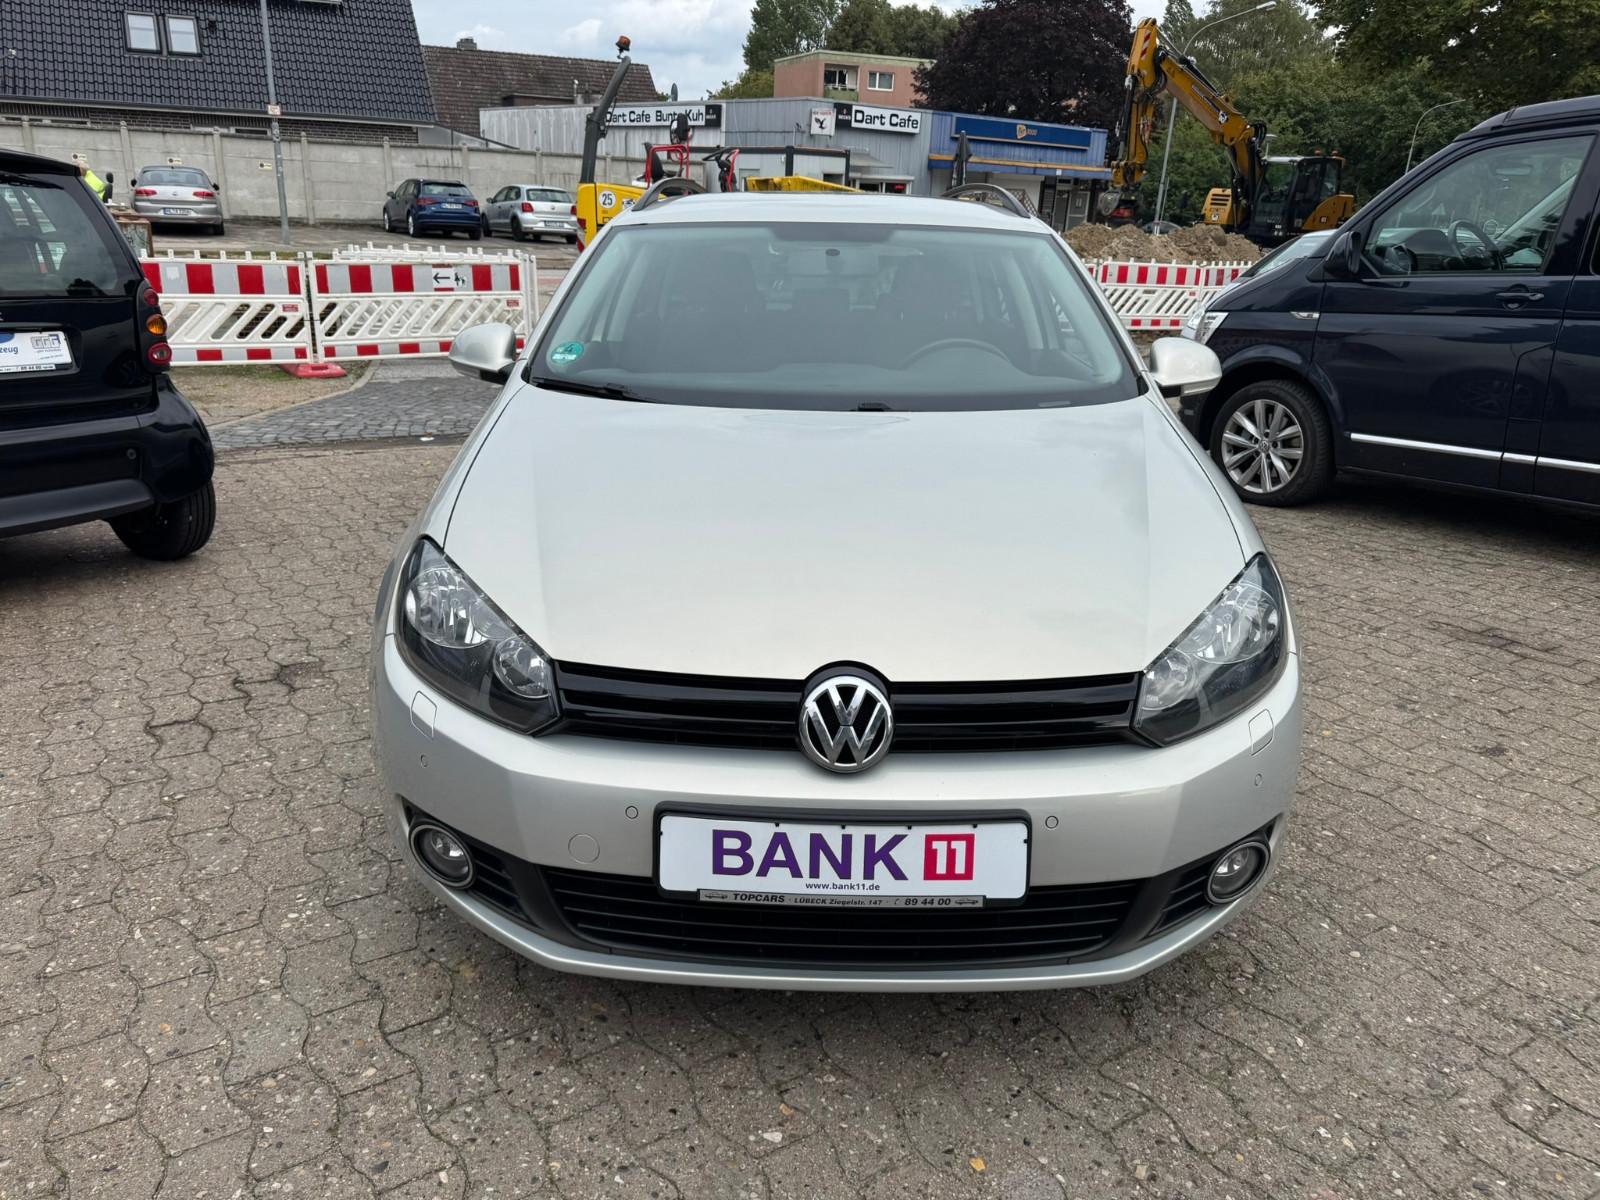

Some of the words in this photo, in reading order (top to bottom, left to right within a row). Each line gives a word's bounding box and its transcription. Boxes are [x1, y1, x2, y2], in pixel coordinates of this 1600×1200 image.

[606, 111, 627, 123] Dart
[629, 110, 651, 123] Cafe
[655, 110, 679, 122] Bunt
[685, 108, 704, 122] Kuh
[853, 109, 886, 126] Dart
[889, 112, 919, 129] Cafe
[602, 193, 613, 206] 25
[711, 828, 909, 882] BANK
[930, 838, 968, 876] 11
[805, 882, 881, 891] www.bank11.de
[732, 893, 785, 903] TOPCARS
[904, 898, 918, 906] 89
[921, 898, 935, 906] 44
[937, 898, 951, 906] 00
